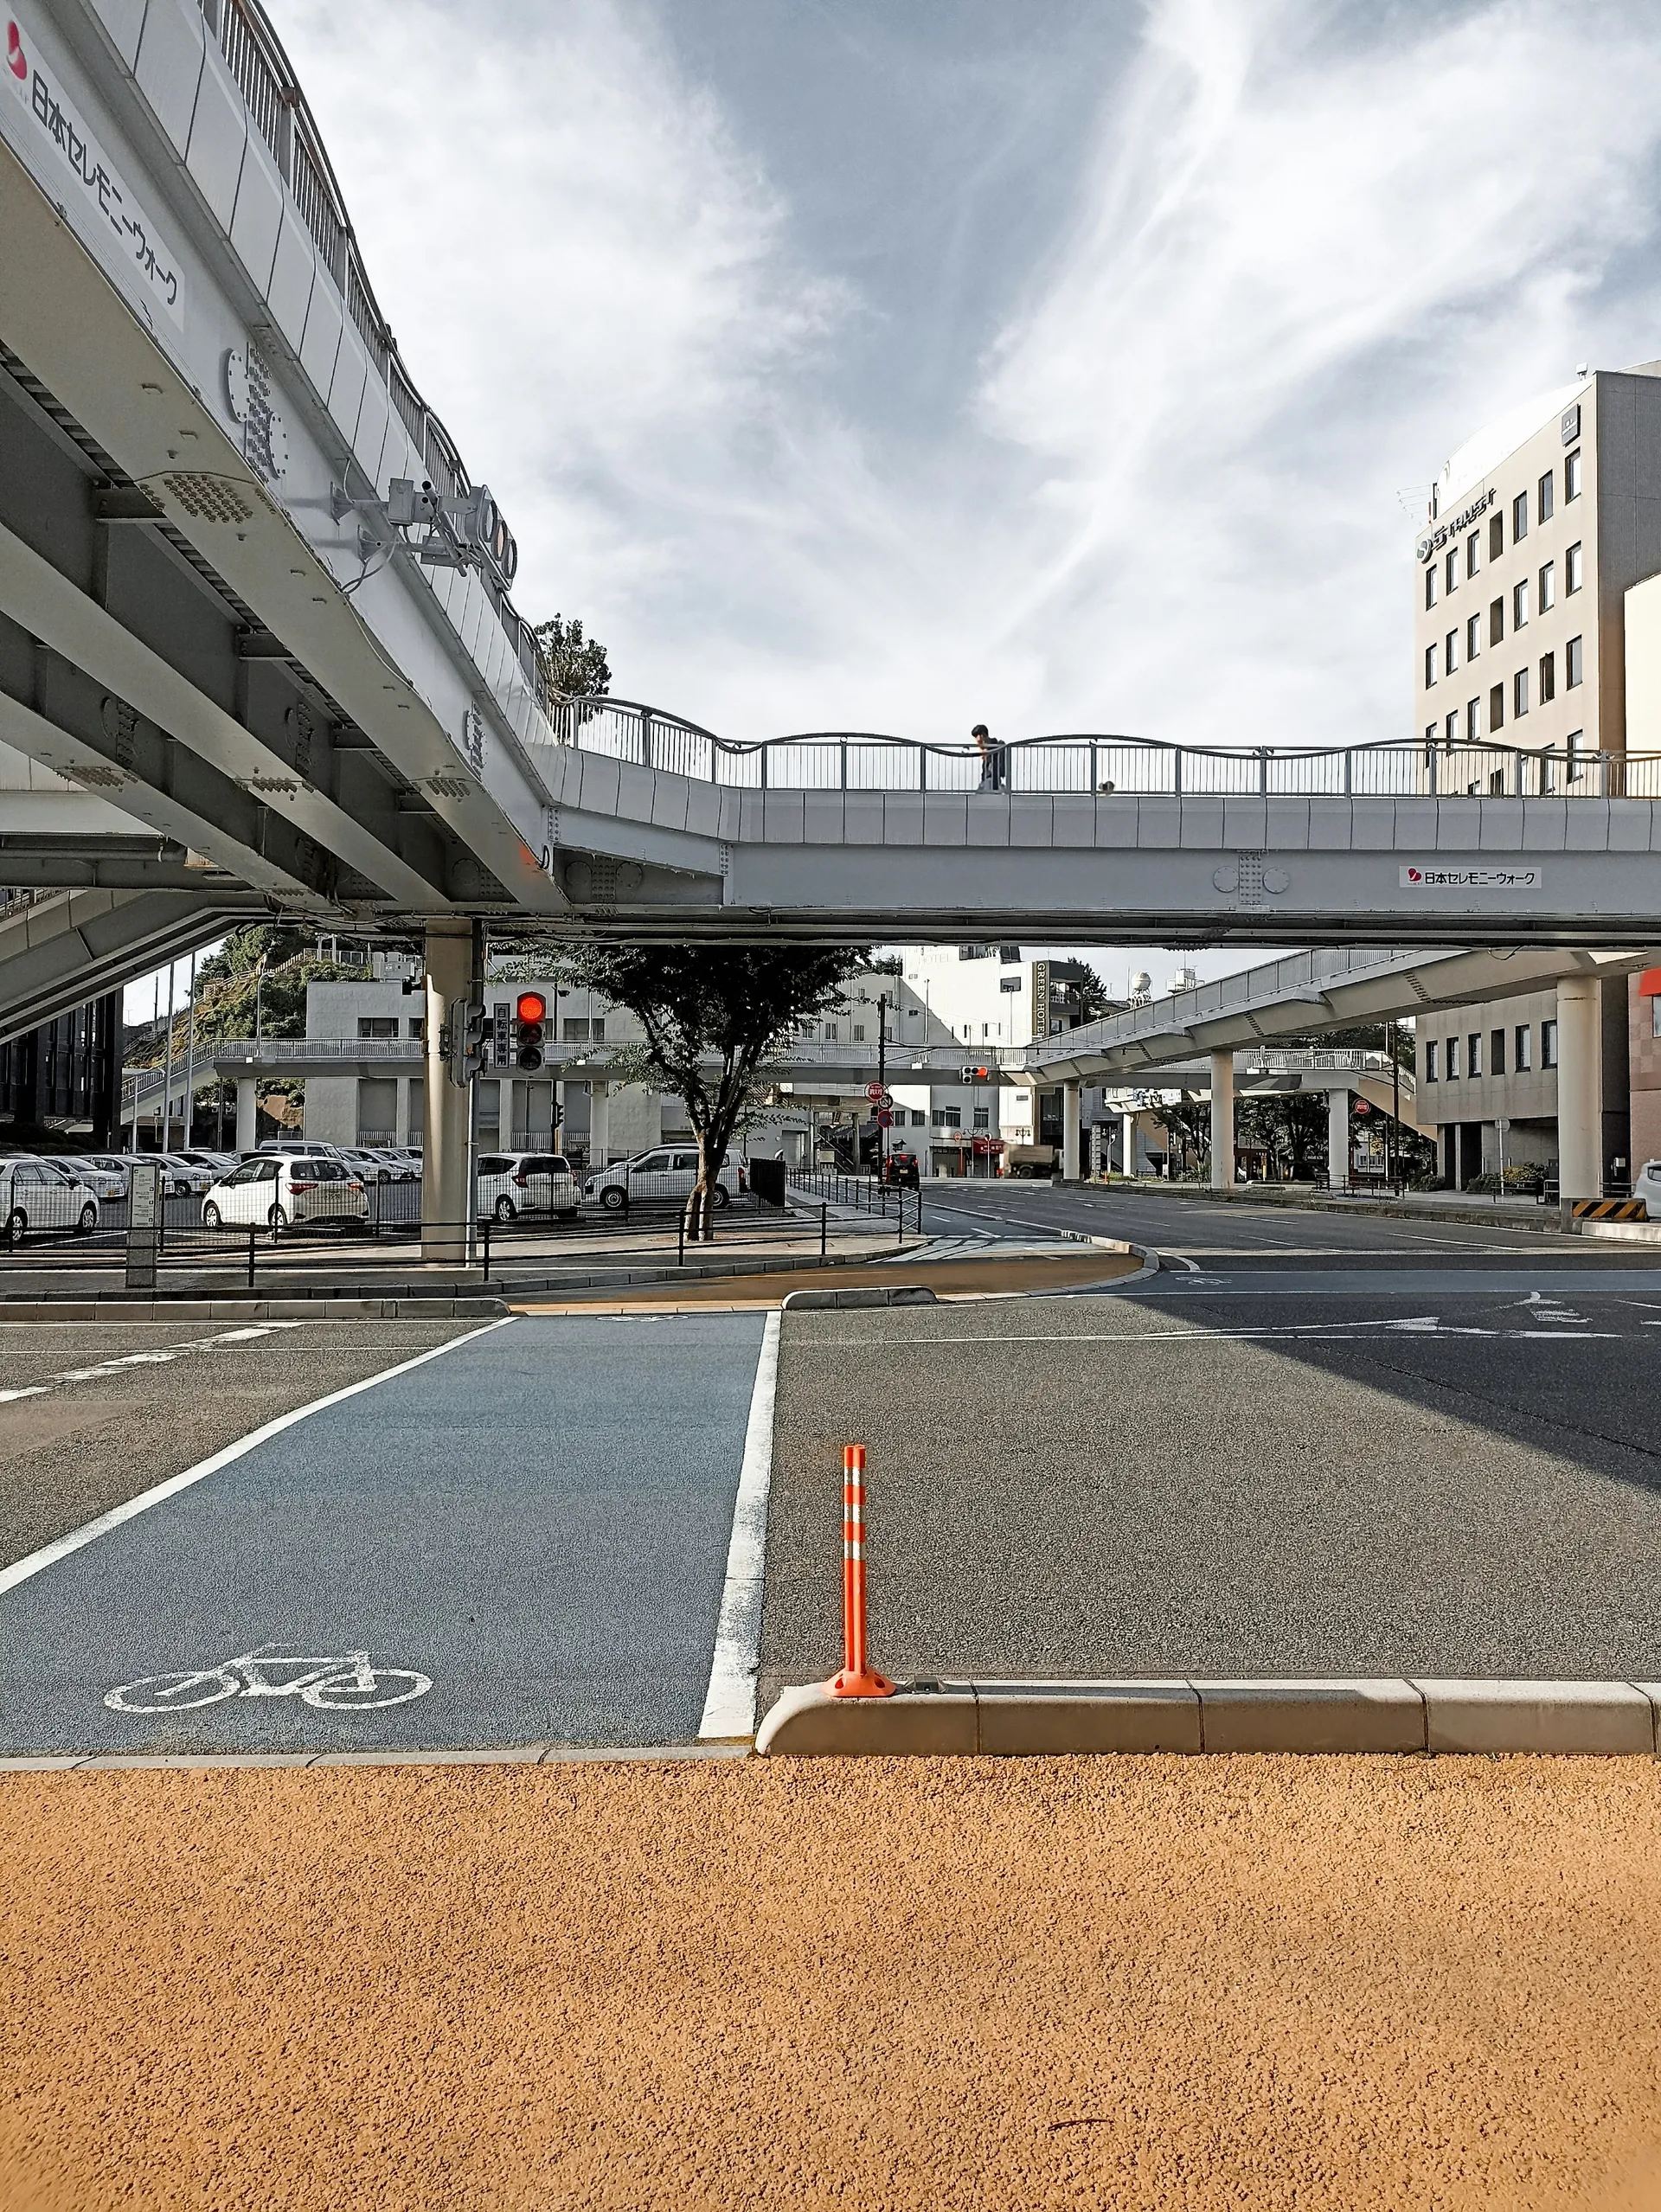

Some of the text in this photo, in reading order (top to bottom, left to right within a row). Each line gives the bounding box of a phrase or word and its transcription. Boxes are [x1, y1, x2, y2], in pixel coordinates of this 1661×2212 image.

[32, 69, 177, 305] 日本セレモニーウォーク
[1425, 872, 1535, 885] 日本セレモニーウォーク
[496, 1005, 507, 1066] 自転車専用
